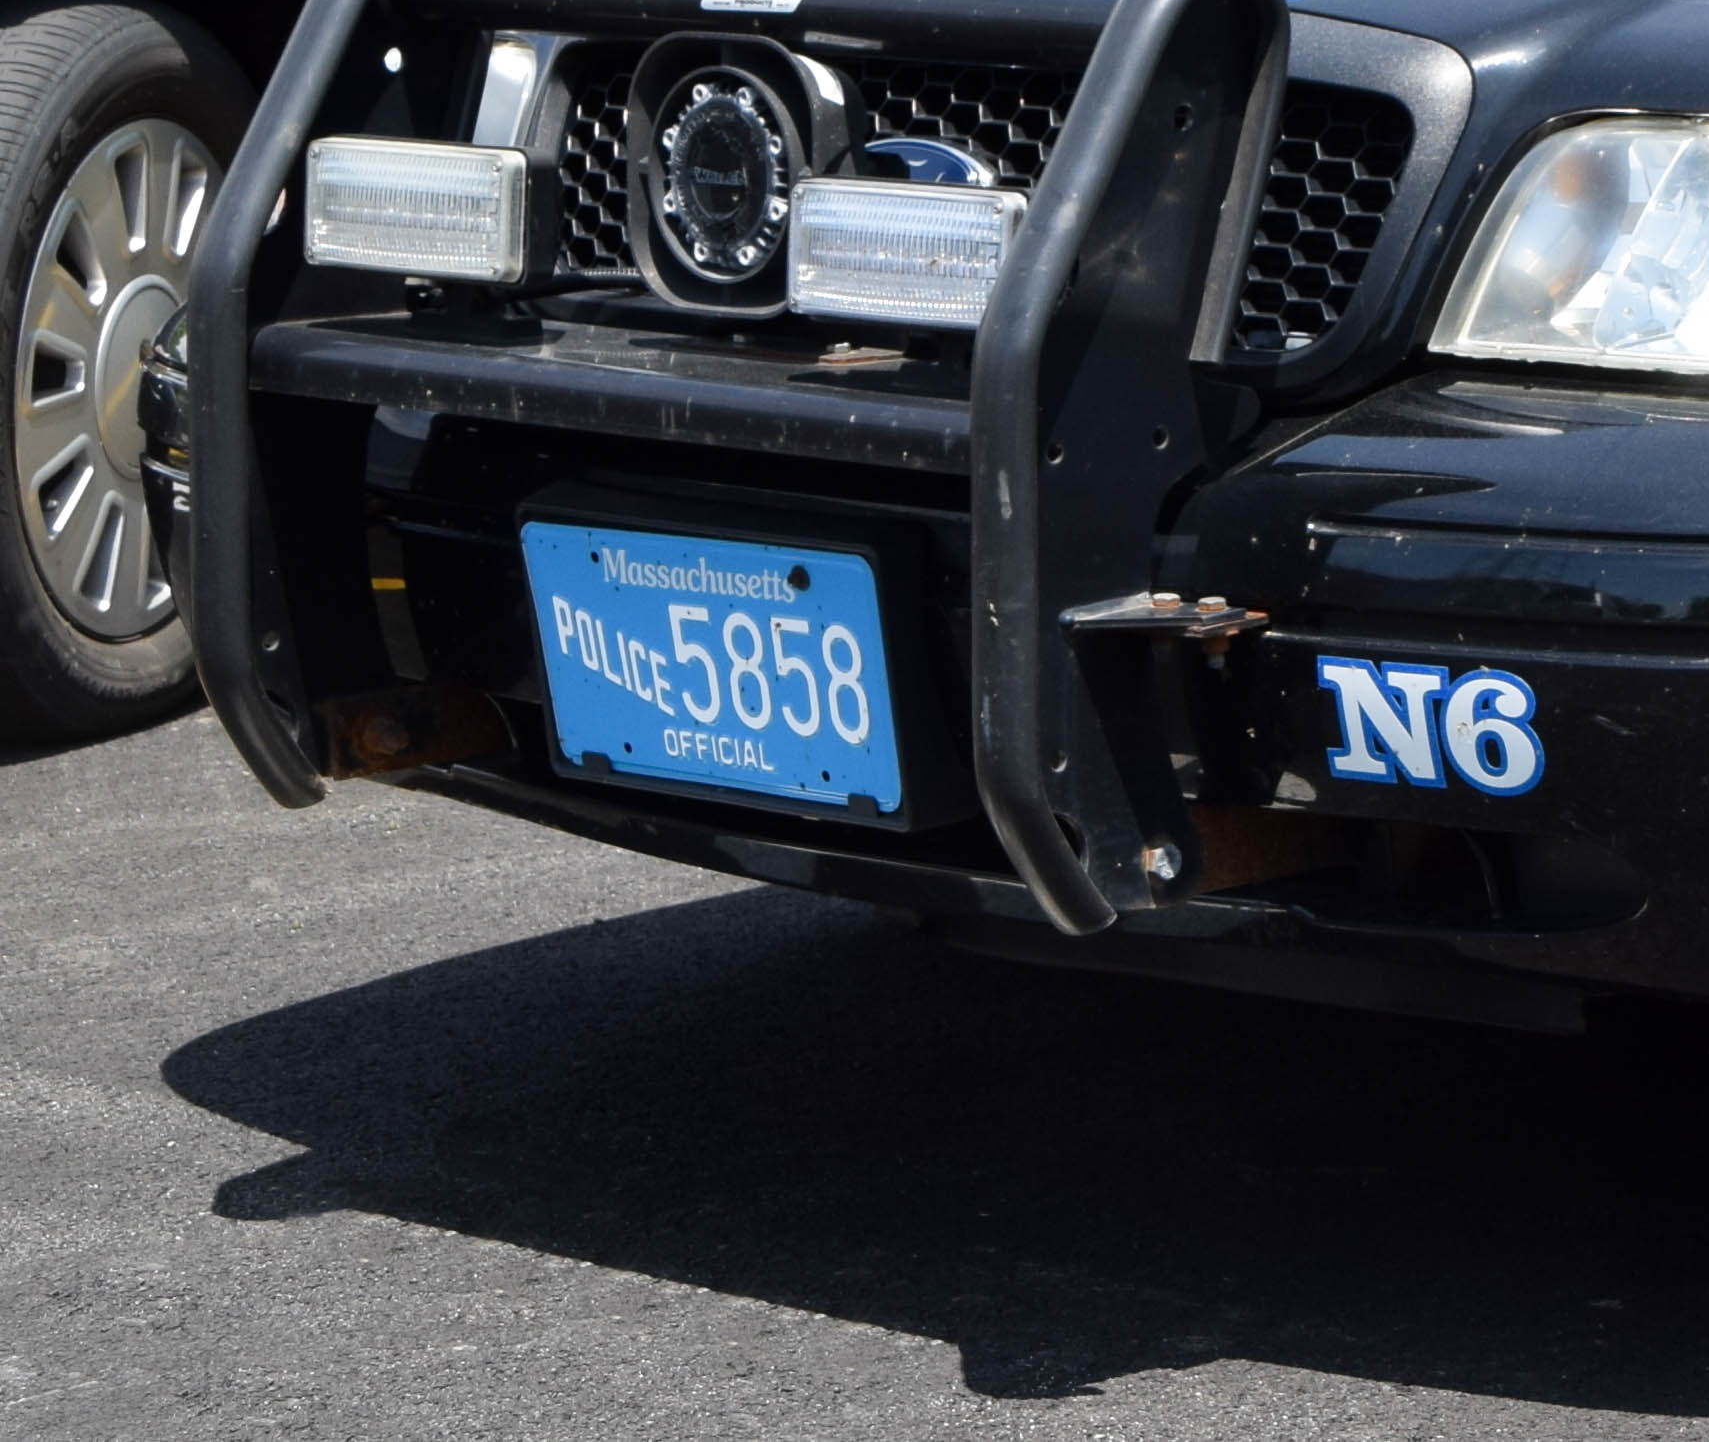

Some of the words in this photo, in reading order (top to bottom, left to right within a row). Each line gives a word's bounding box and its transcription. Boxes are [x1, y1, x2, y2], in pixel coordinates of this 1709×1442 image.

[601, 547, 796, 603] Massachusetts
[552, 595, 676, 718] POLICE
[668, 603, 870, 745] 5858
[663, 729, 774, 772] OFFICIAL
[1317, 654, 1545, 797] N6
